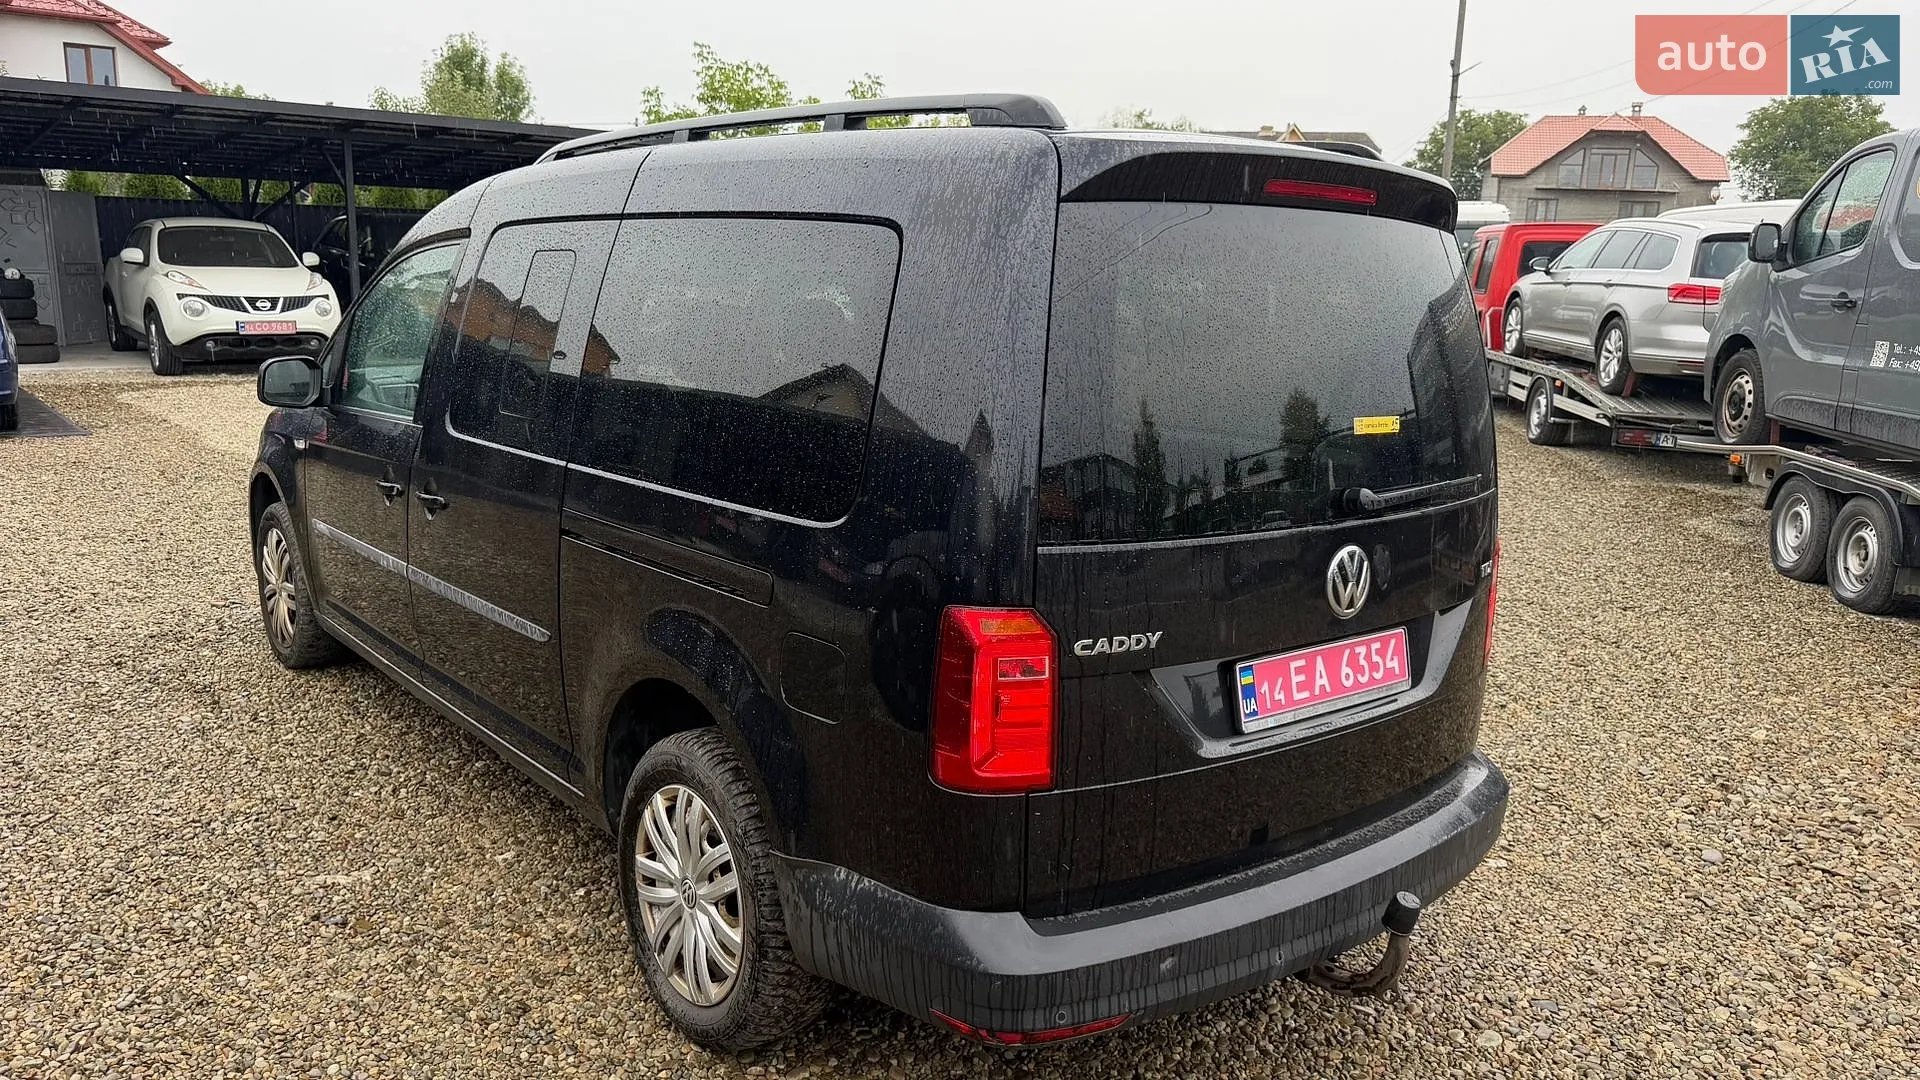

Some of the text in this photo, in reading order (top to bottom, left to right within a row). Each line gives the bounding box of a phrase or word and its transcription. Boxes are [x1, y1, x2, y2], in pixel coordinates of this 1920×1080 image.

[255, 322, 269, 331] CO
[1073, 631, 1163, 656] CADDY
[1260, 637, 1400, 709] 14 EA 6354
[1243, 698, 1258, 714] UA
